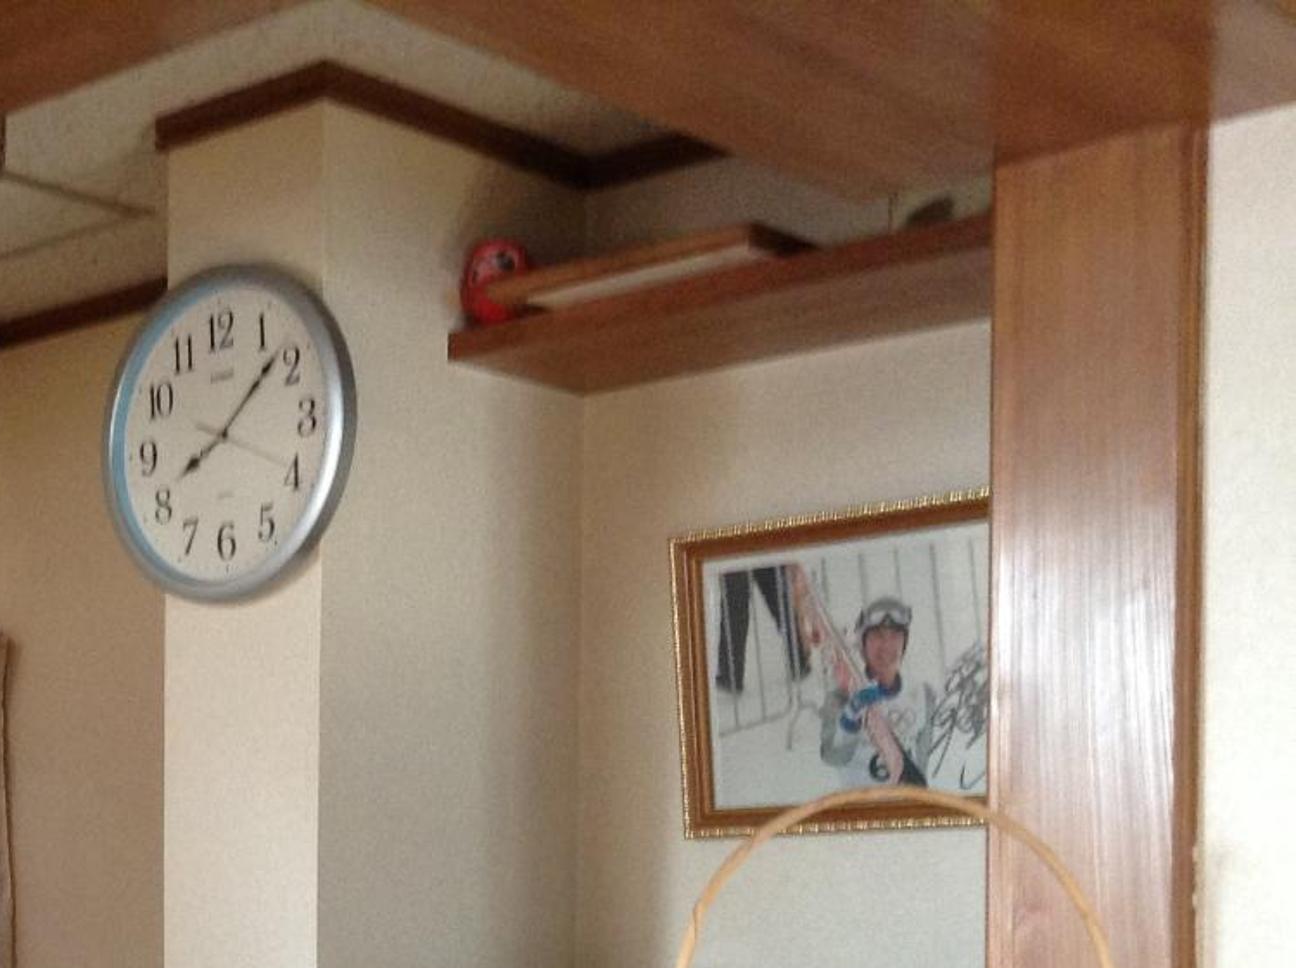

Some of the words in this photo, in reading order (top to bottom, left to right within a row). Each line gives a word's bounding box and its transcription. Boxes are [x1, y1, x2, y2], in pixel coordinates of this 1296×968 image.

[208, 311, 234, 351] 12
[258, 313, 266, 350] 1
[174, 334, 194, 375] 11
[283, 347, 301, 387] 2
[149, 382, 174, 421] 10
[298, 399, 317, 437] 3
[140, 441, 158, 477] 9
[284, 452, 300, 491] 4
[155, 489, 173, 525] 8
[258, 502, 275, 541] 5
[183, 518, 199, 556] 7
[217, 521, 237, 562] 6
